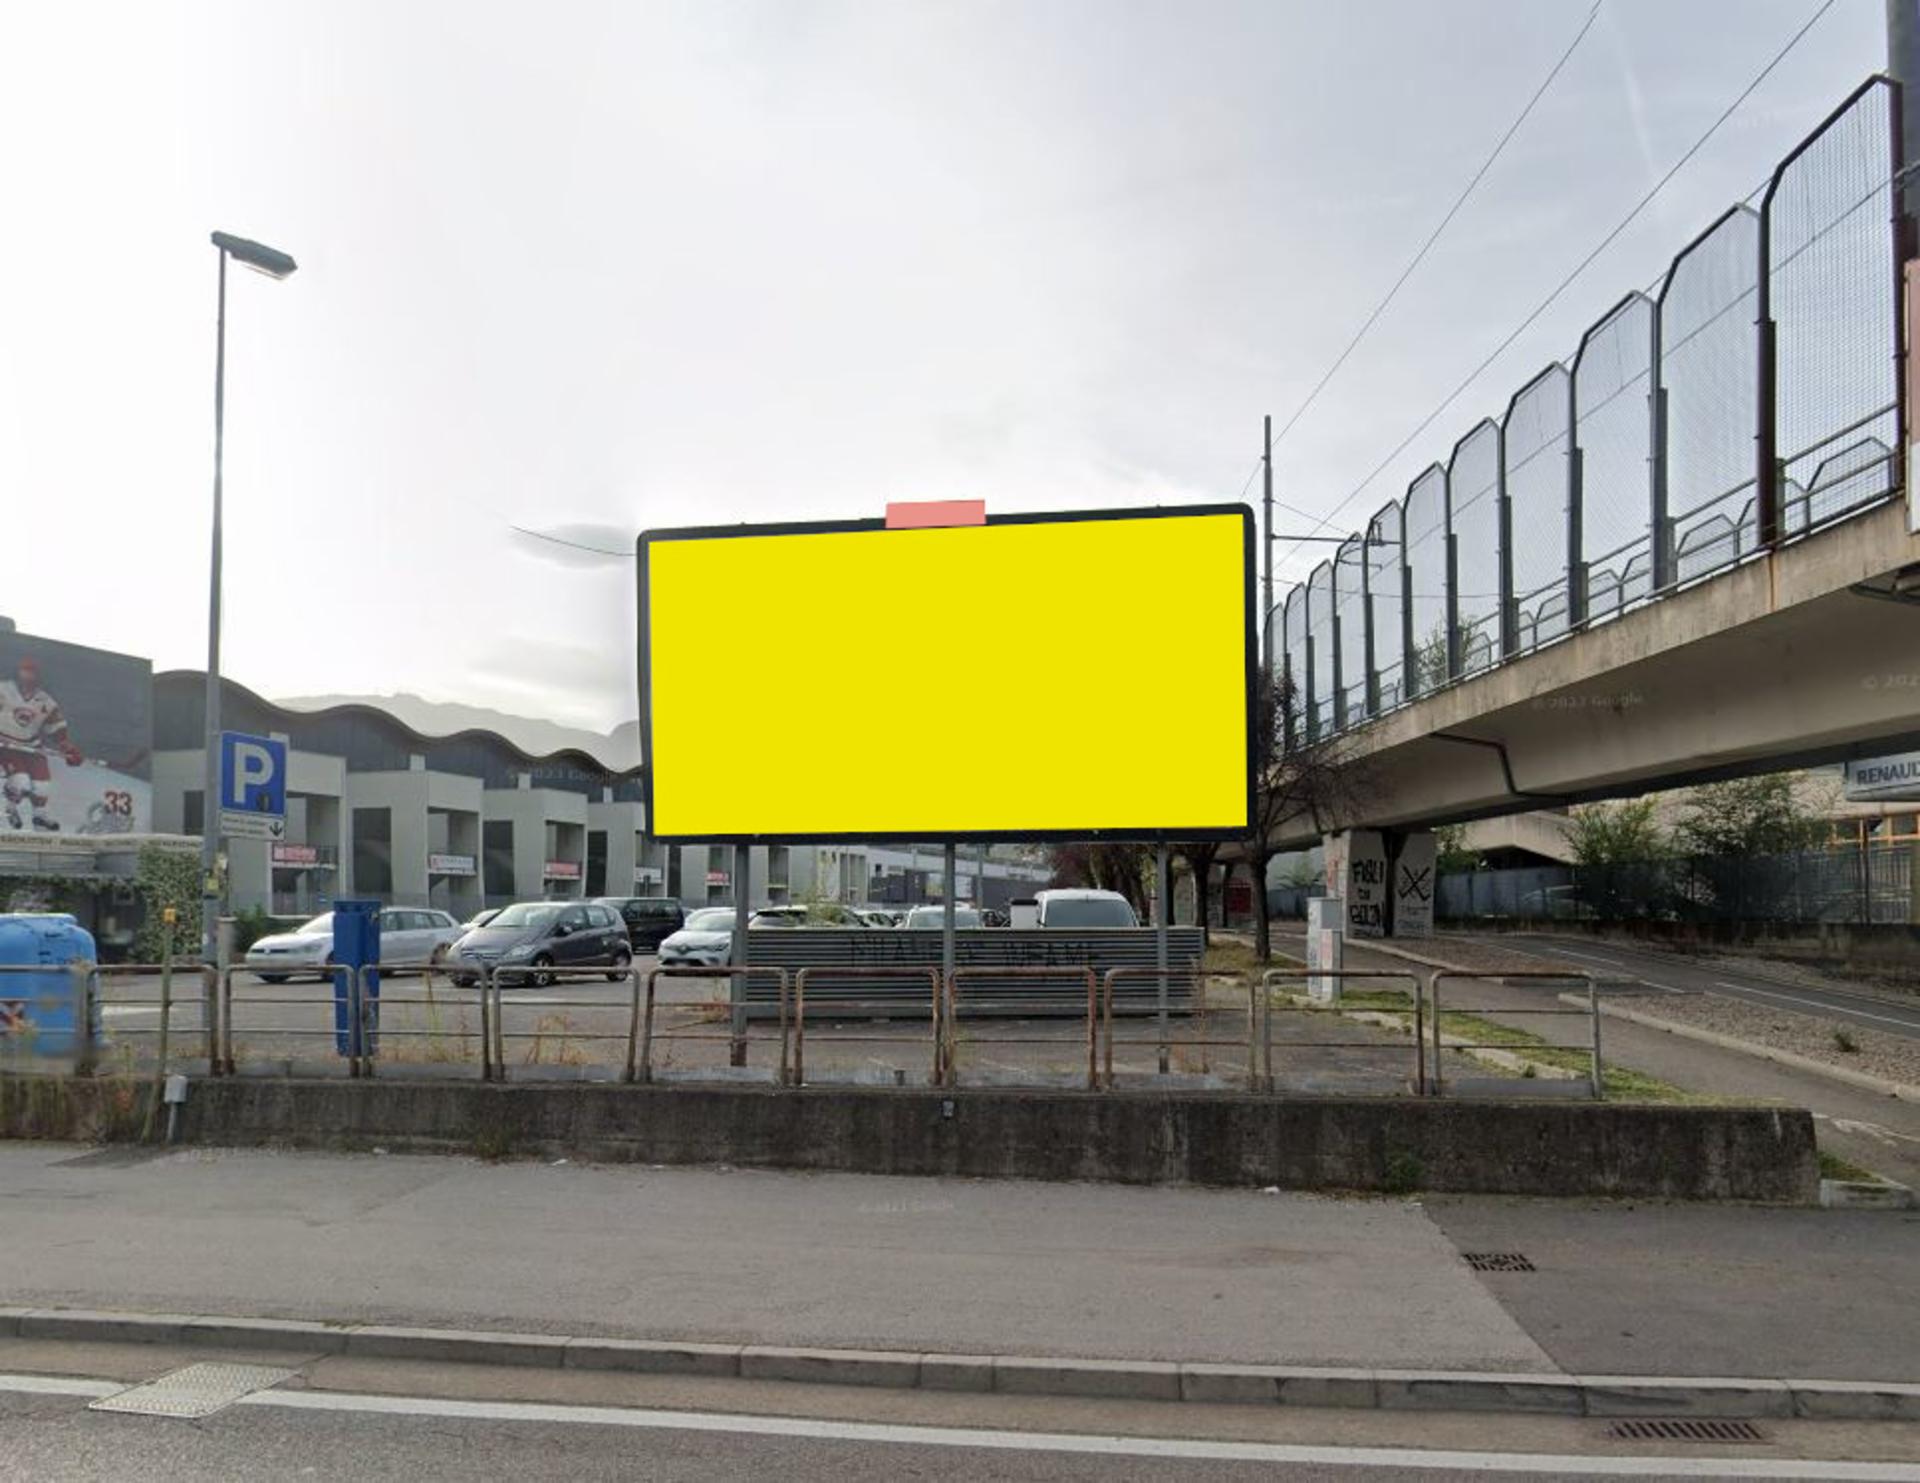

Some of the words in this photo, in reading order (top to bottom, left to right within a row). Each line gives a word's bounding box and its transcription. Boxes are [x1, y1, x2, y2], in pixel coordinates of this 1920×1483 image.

[234, 742, 274, 804] P
[1857, 760, 1920, 785] RENAUL
[104, 791, 132, 816] 33
